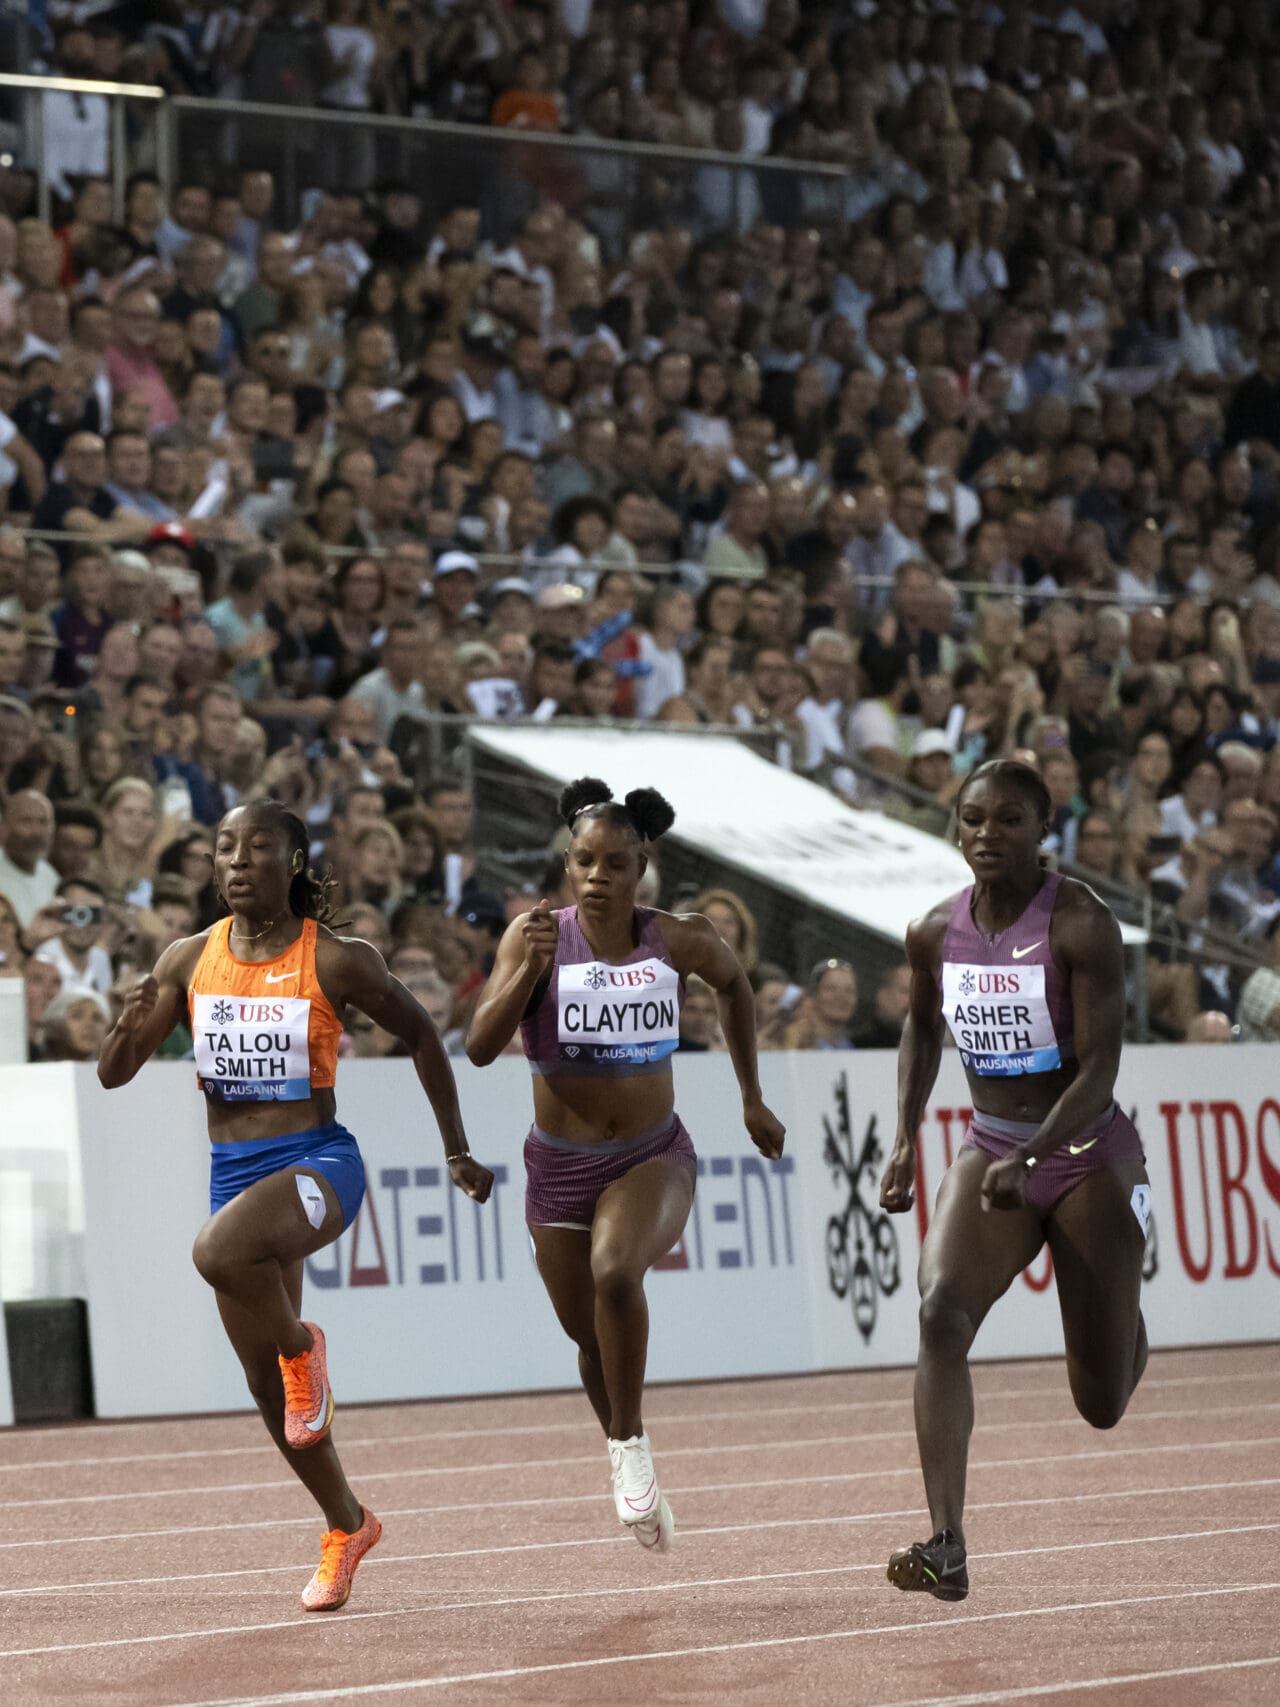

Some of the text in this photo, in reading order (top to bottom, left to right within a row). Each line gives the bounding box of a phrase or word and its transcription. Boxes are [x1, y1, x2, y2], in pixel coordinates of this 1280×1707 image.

[608, 966, 657, 988] UBS
[978, 973, 1020, 993] UBS
[238, 1004, 284, 1022] UBS
[564, 999, 674, 1032] CLAYTON
[954, 1004, 1032, 1026] ASHER
[205, 1033, 291, 1052] TA LOU
[961, 1030, 1032, 1051] SMITH
[594, 1046, 657, 1059] LAUSANNE
[215, 1057, 287, 1078] SMITH
[975, 1056, 1035, 1070] LAUSANNE
[223, 1084, 287, 1096] LAUSANNE
